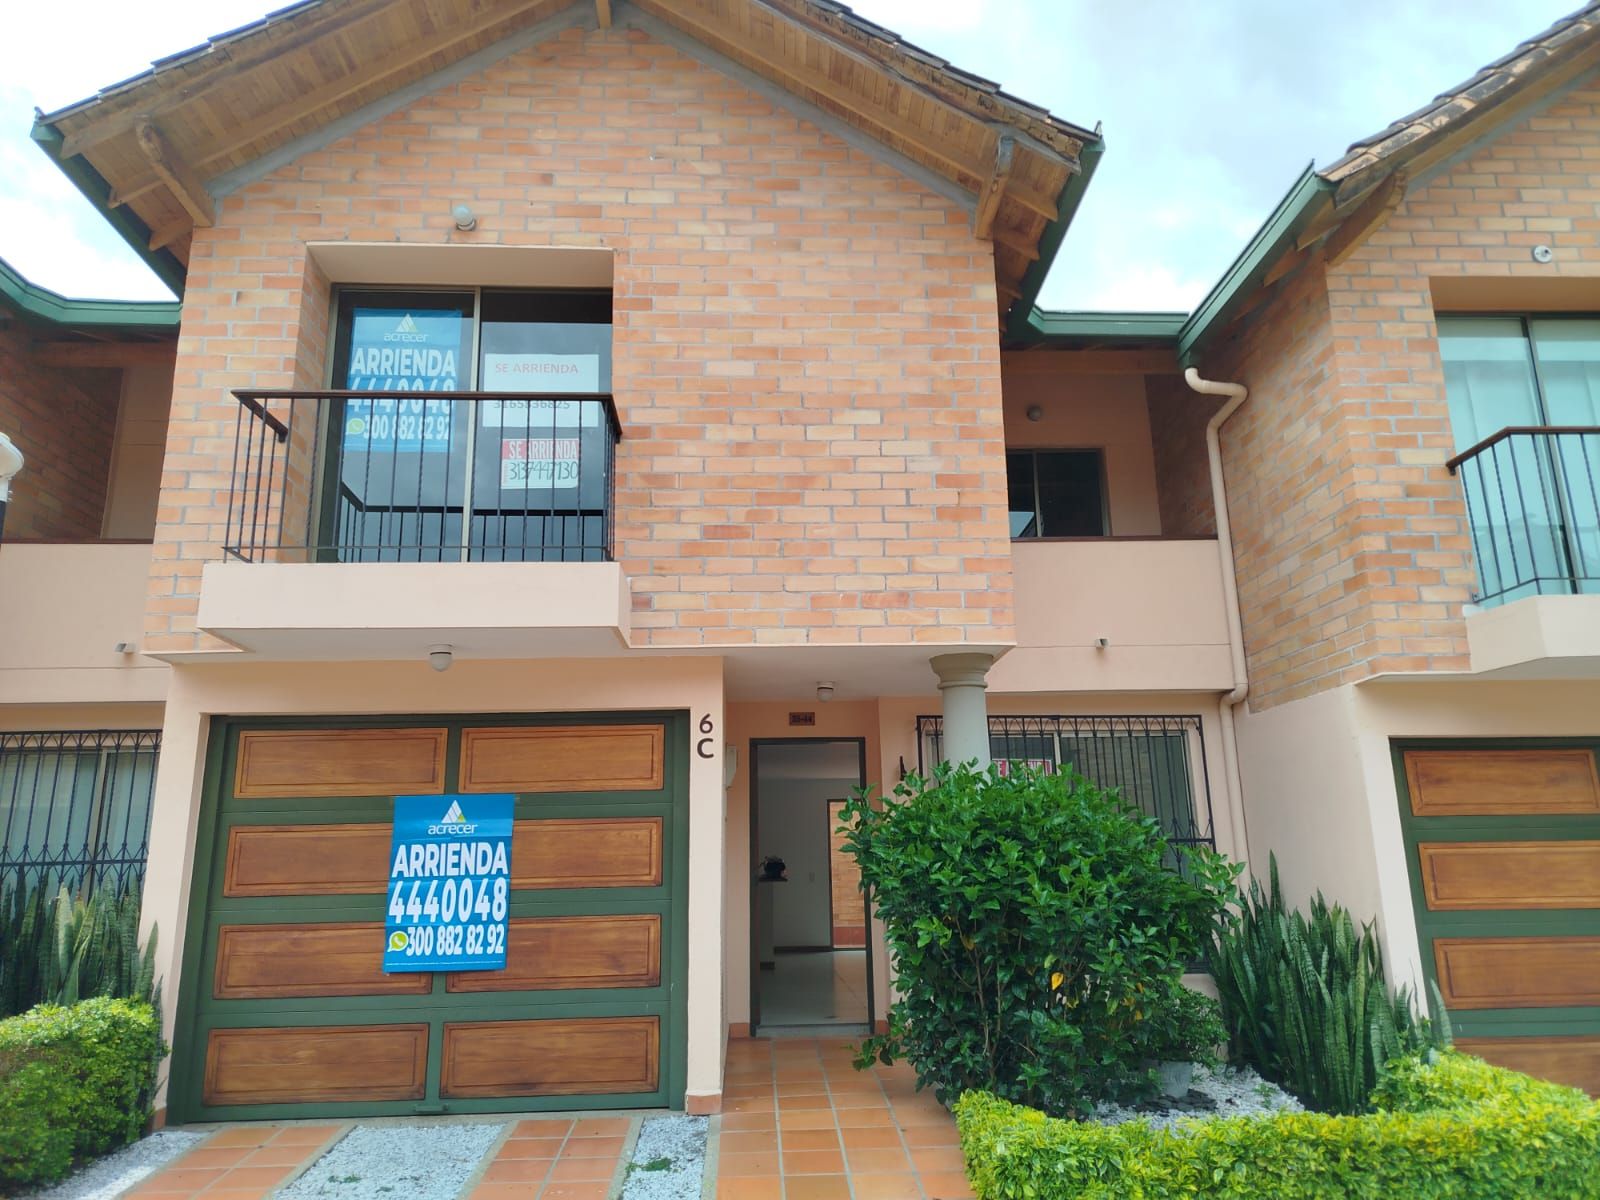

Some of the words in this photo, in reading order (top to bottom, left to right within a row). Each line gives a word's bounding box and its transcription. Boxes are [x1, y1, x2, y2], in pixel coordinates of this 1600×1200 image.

[384, 332, 429, 343] acrecer
[350, 347, 457, 377] ARRIENDA
[495, 363, 509, 373] SE
[512, 363, 579, 374] ARRIENDA
[509, 440, 523, 459] SE
[427, 823, 478, 835] acrecer
[391, 842, 509, 878] ARRIENDA
[388, 877, 507, 924] 4440048
[405, 926, 434, 956] 300
[436, 925, 463, 956] 882
[465, 924, 485, 955] 82
[486, 923, 505, 955] 92
